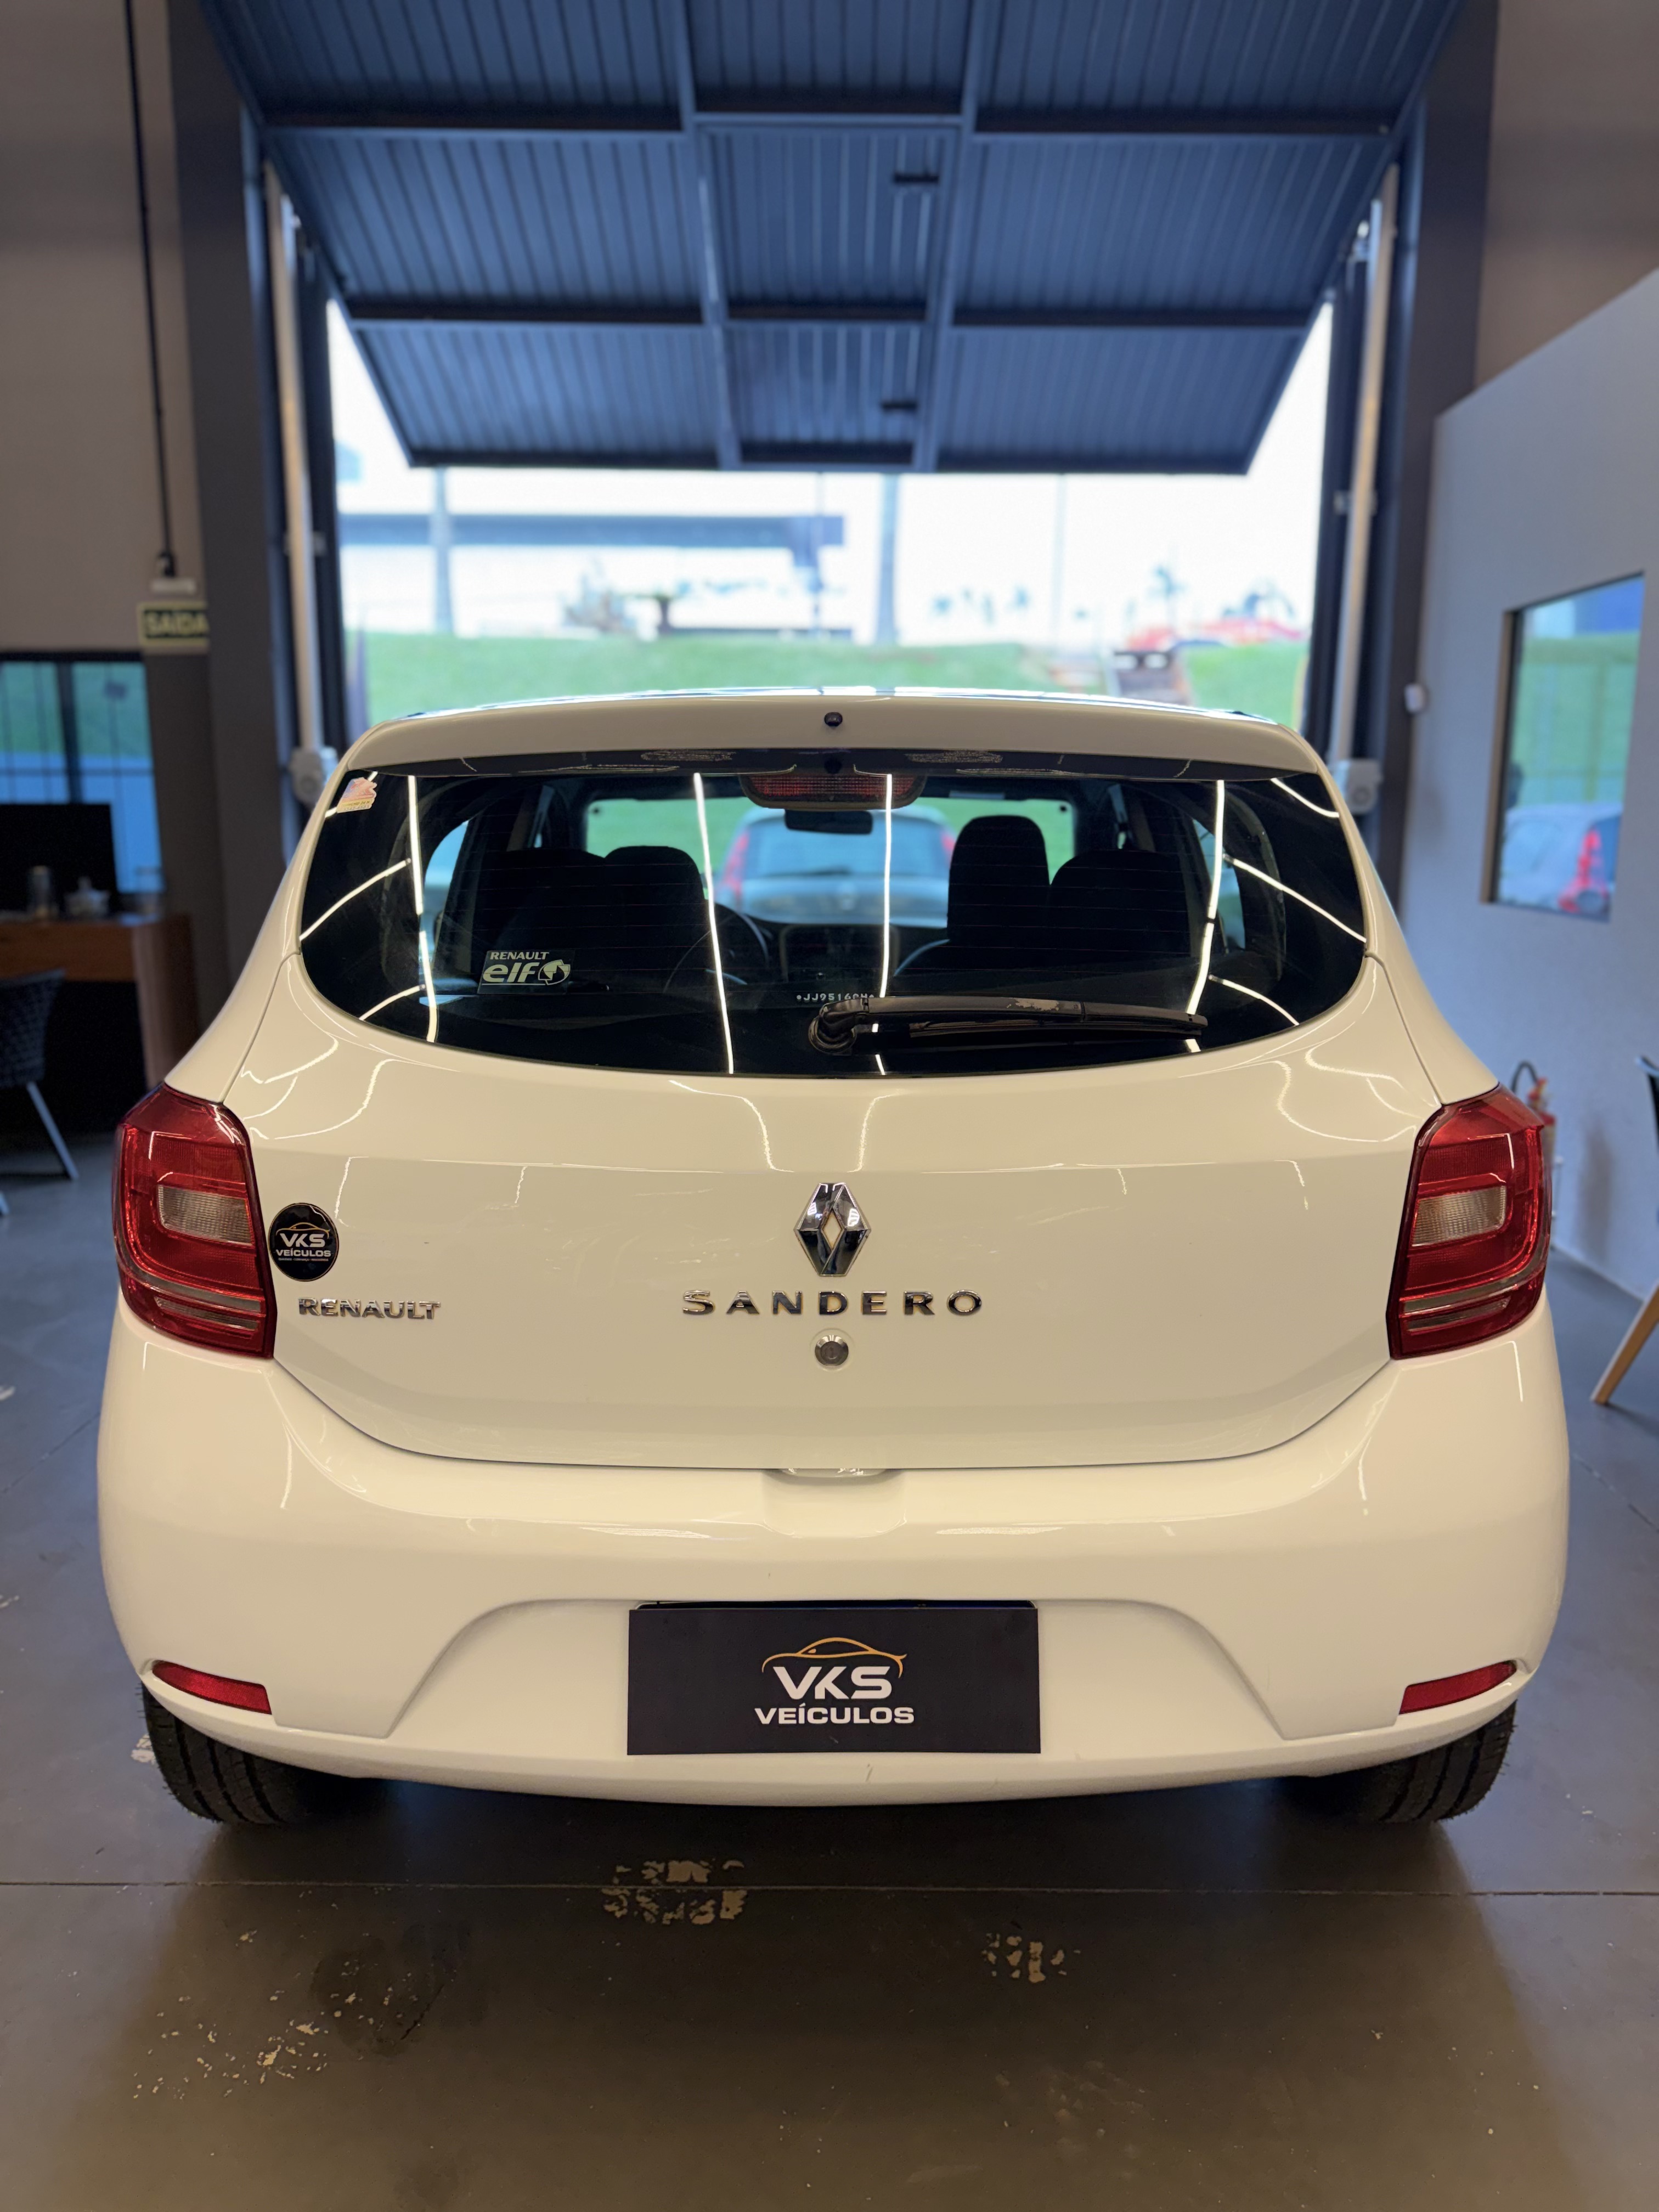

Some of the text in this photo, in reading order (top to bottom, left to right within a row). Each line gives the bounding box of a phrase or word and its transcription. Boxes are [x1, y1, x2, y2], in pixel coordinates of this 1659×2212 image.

[490, 952, 550, 960] RENAULT
[483, 962, 540, 983] elf
[279, 1233, 325, 1248] VKS
[276, 1248, 331, 1257] VEÍCULOS
[297, 1297, 441, 1319] RENAULT
[682, 1289, 983, 1316] SANDERO
[772, 1666, 892, 1700] VKS
[754, 1703, 915, 1725] VEÍCULOS
